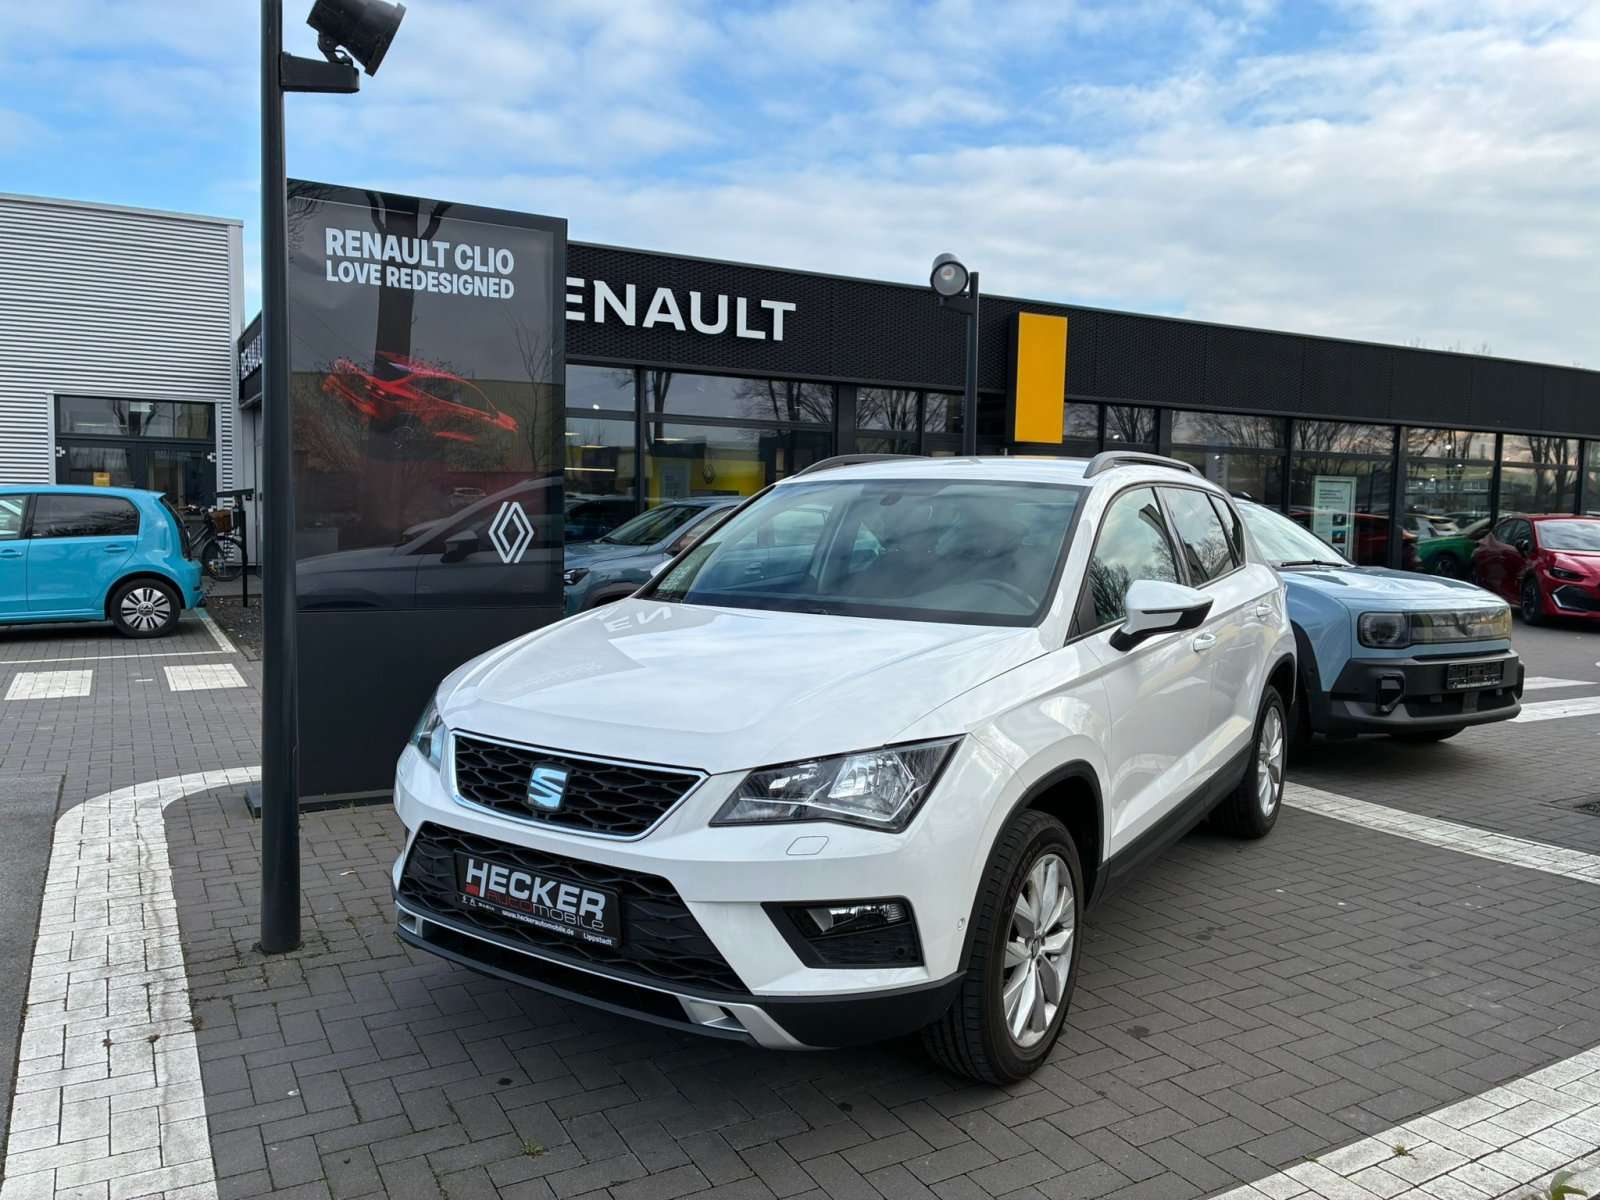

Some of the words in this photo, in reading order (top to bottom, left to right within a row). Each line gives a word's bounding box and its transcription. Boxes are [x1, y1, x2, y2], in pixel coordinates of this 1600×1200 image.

[326, 228, 450, 268] RENAULT
[454, 243, 515, 275] CLIO
[326, 259, 382, 286] LOVE
[386, 266, 515, 299] REDESIGNED
[565, 276, 797, 341] ENAULT
[466, 858, 606, 920] HECKER
[583, 932, 613, 946] Lippstadt
